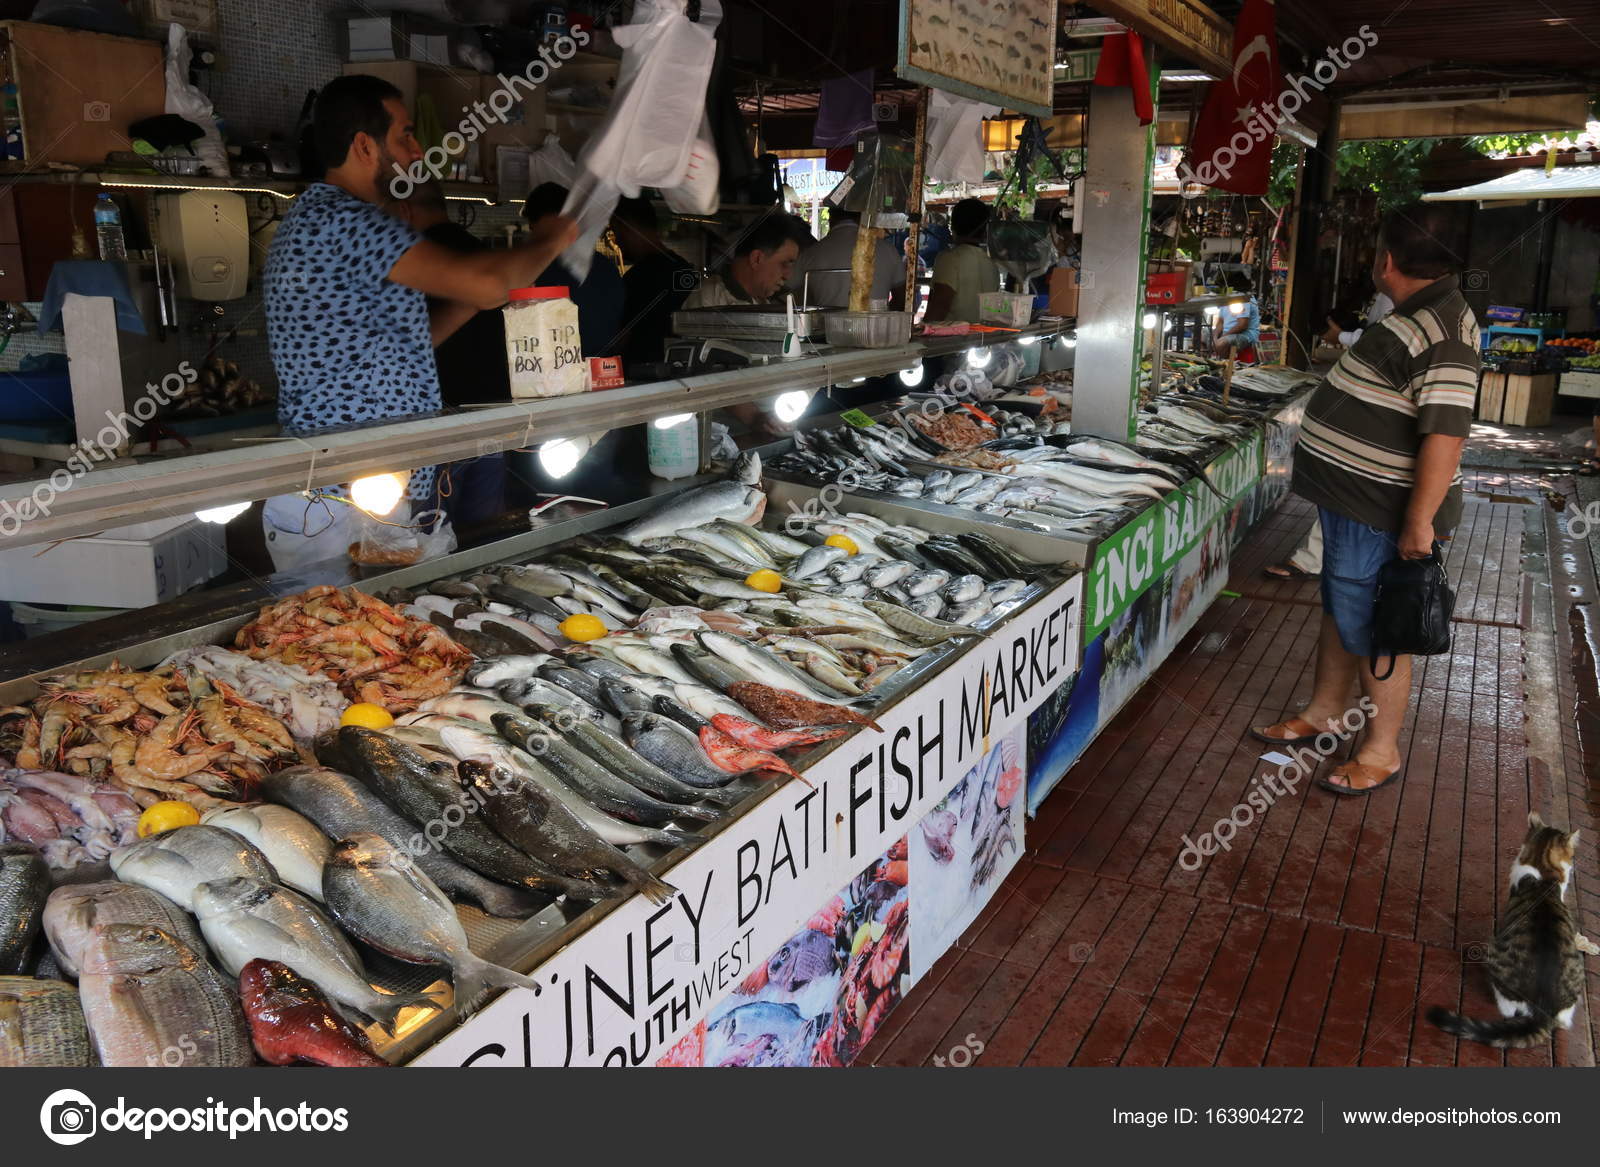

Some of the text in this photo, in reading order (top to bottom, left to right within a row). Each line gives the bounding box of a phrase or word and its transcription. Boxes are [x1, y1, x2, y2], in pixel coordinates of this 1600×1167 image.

[515, 355, 543, 374] BOX
[554, 345, 583, 370] BOX
[460, 596, 1075, 1067] ÜNEY BATI FISH MARKET
